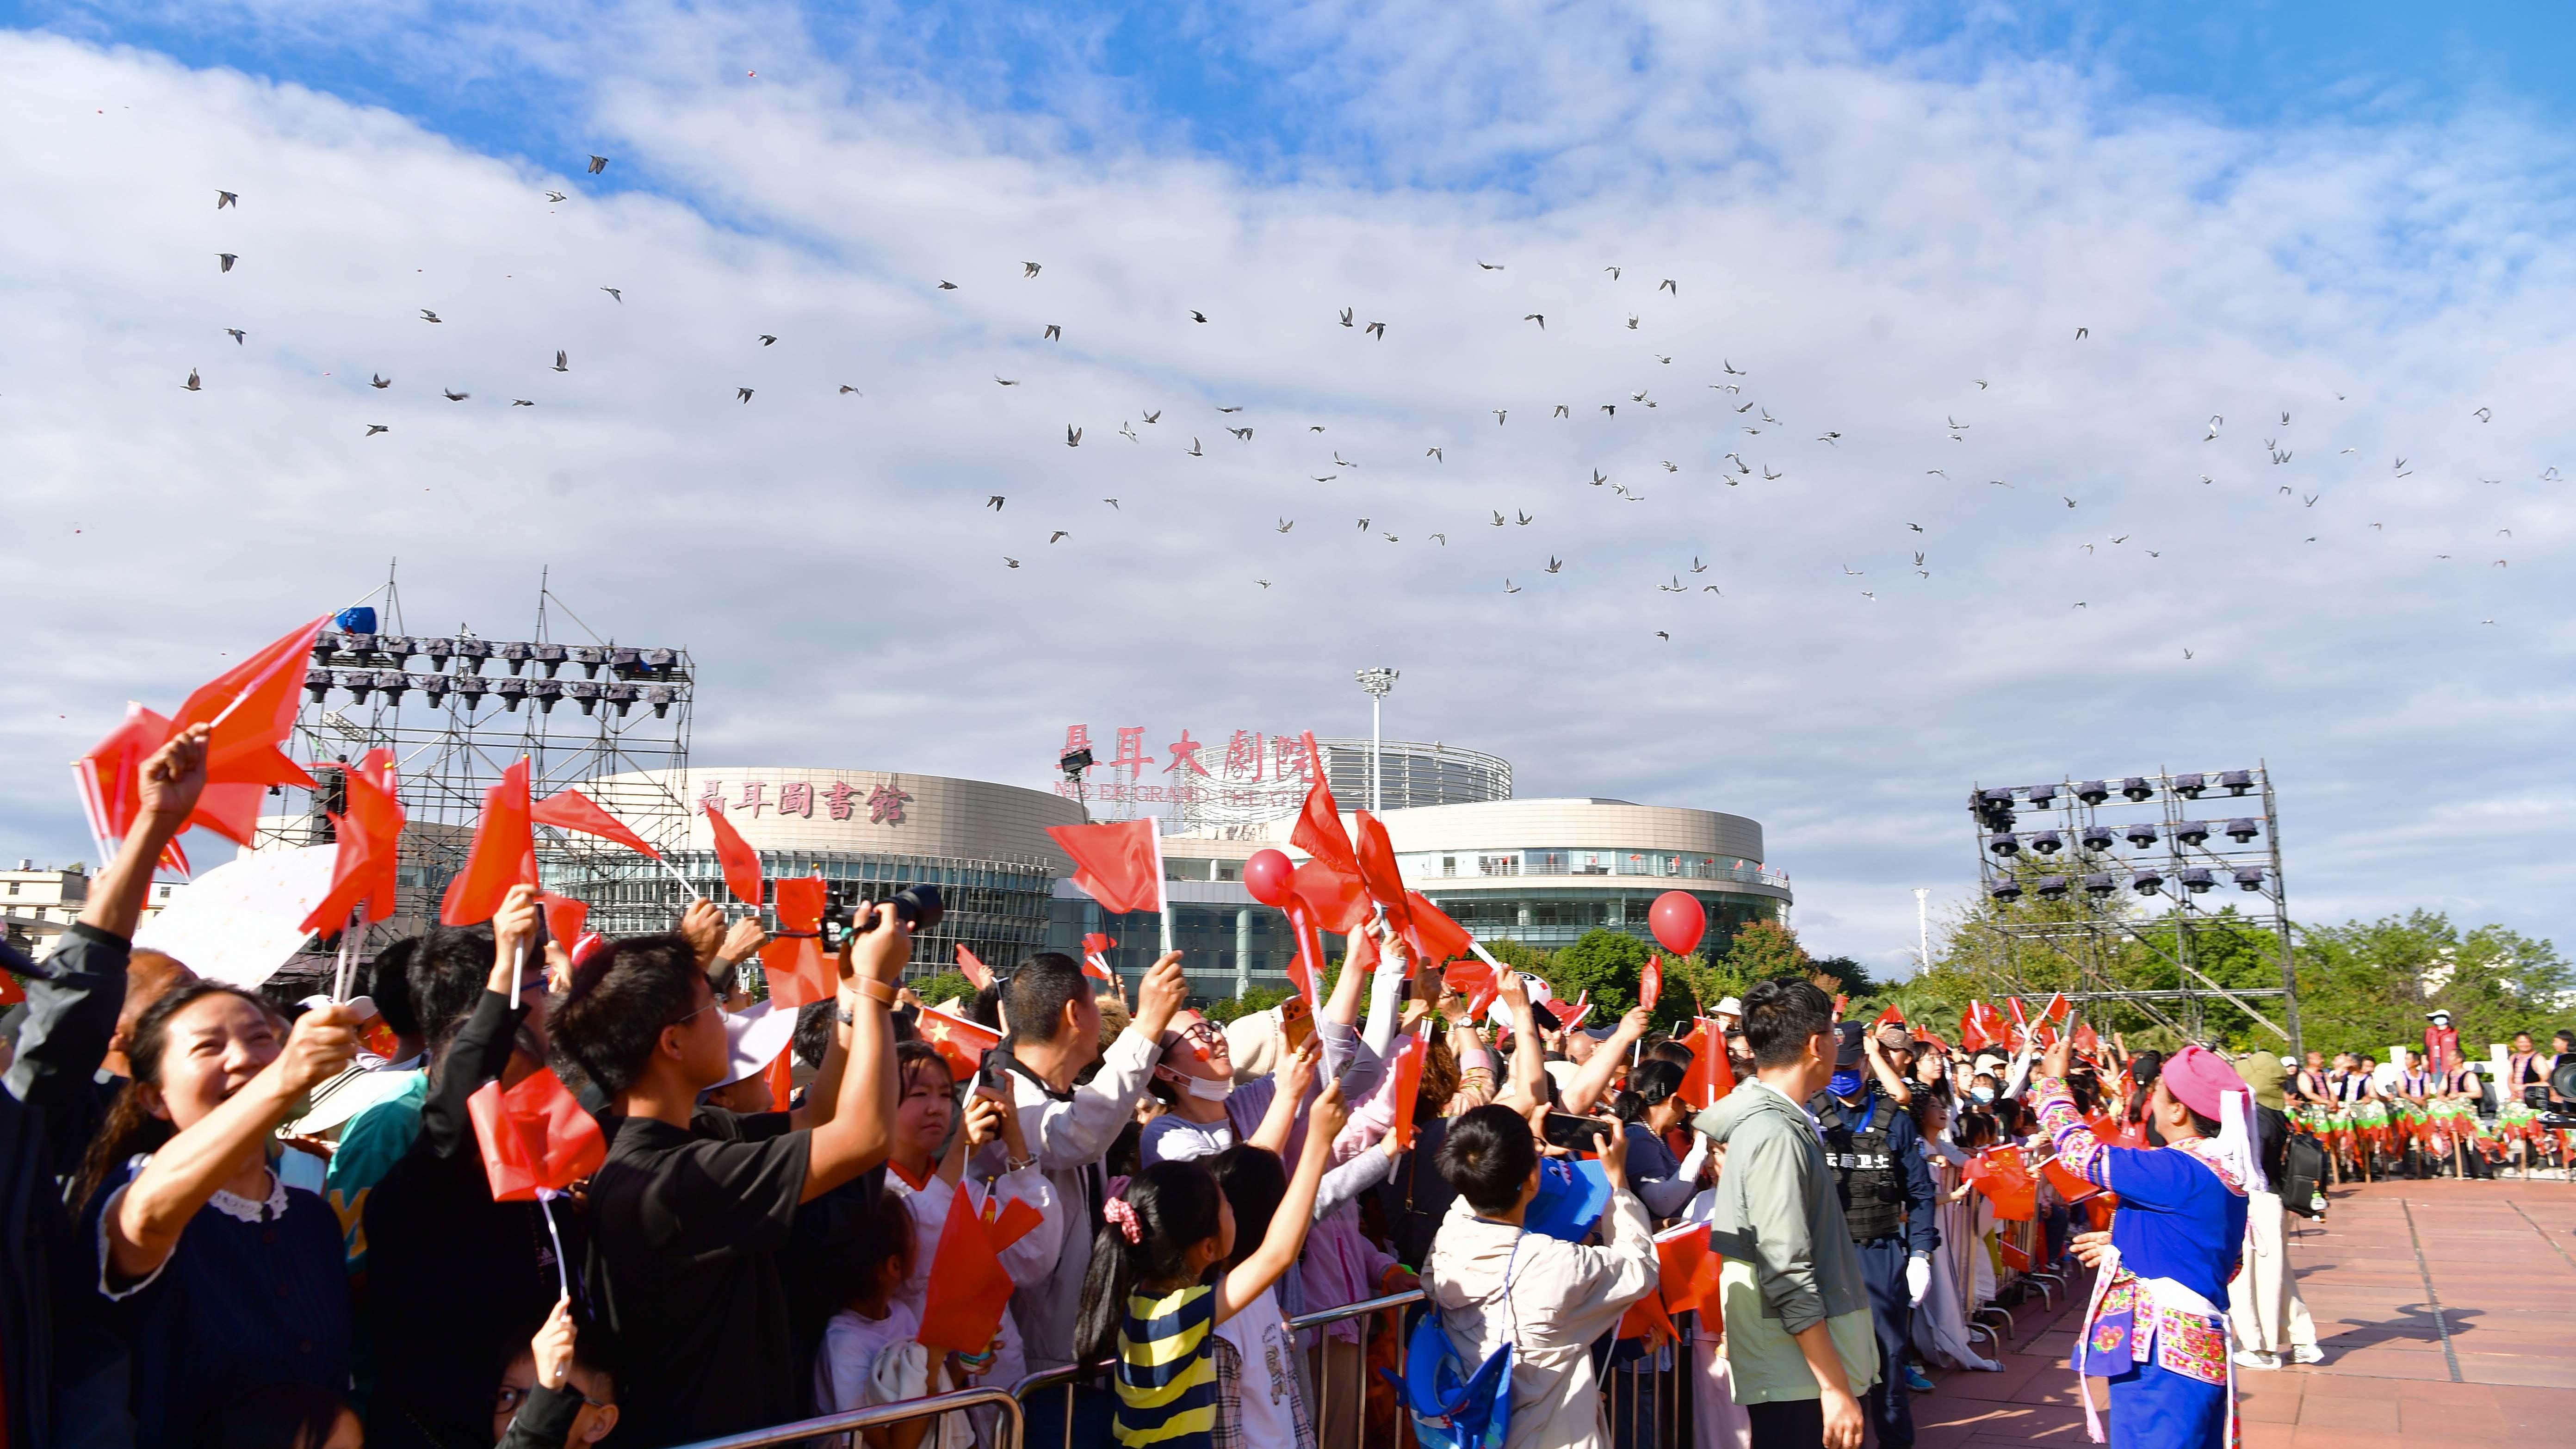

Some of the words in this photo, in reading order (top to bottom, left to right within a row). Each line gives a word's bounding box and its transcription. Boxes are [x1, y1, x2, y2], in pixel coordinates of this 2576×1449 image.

[1134, 786, 1208, 804] GRAND
[1825, 1153, 1889, 1169] 云盾卫士
